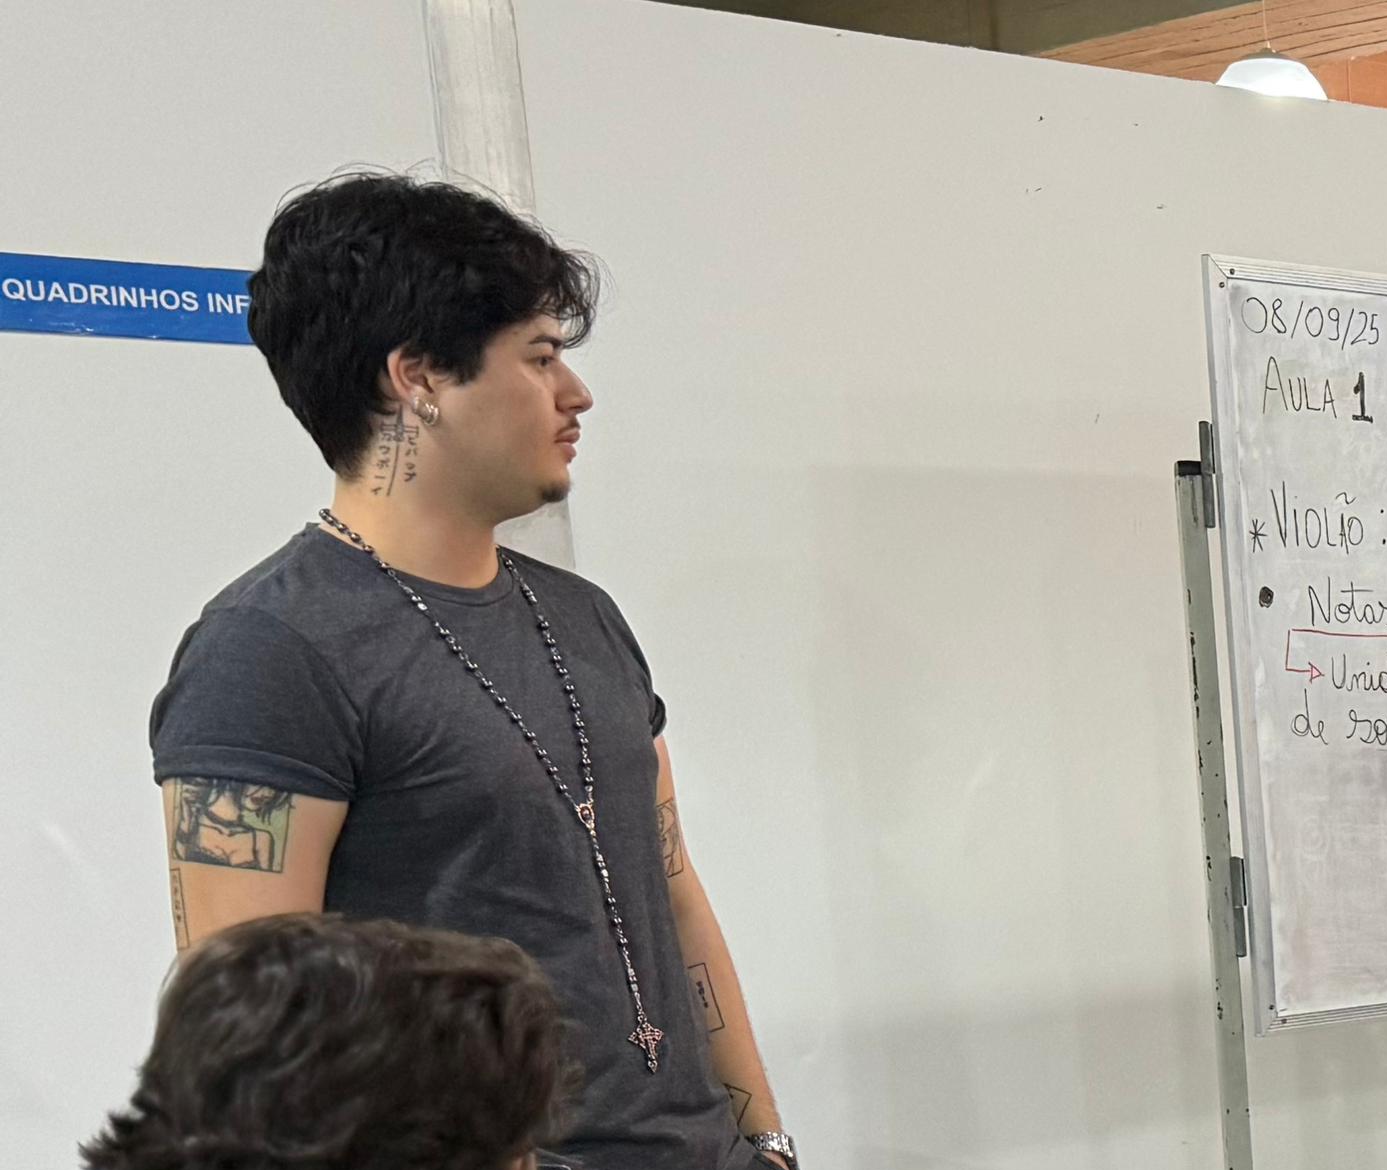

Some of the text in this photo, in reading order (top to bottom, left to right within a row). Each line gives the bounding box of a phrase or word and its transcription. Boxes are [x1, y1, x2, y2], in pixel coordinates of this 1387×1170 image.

[2, 277, 250, 314] QUADRINHOS INF
[1241, 296, 1380, 350] 08/09/25
[1263, 356, 1374, 424] AULA 1
[1292, 687, 1328, 745] de
